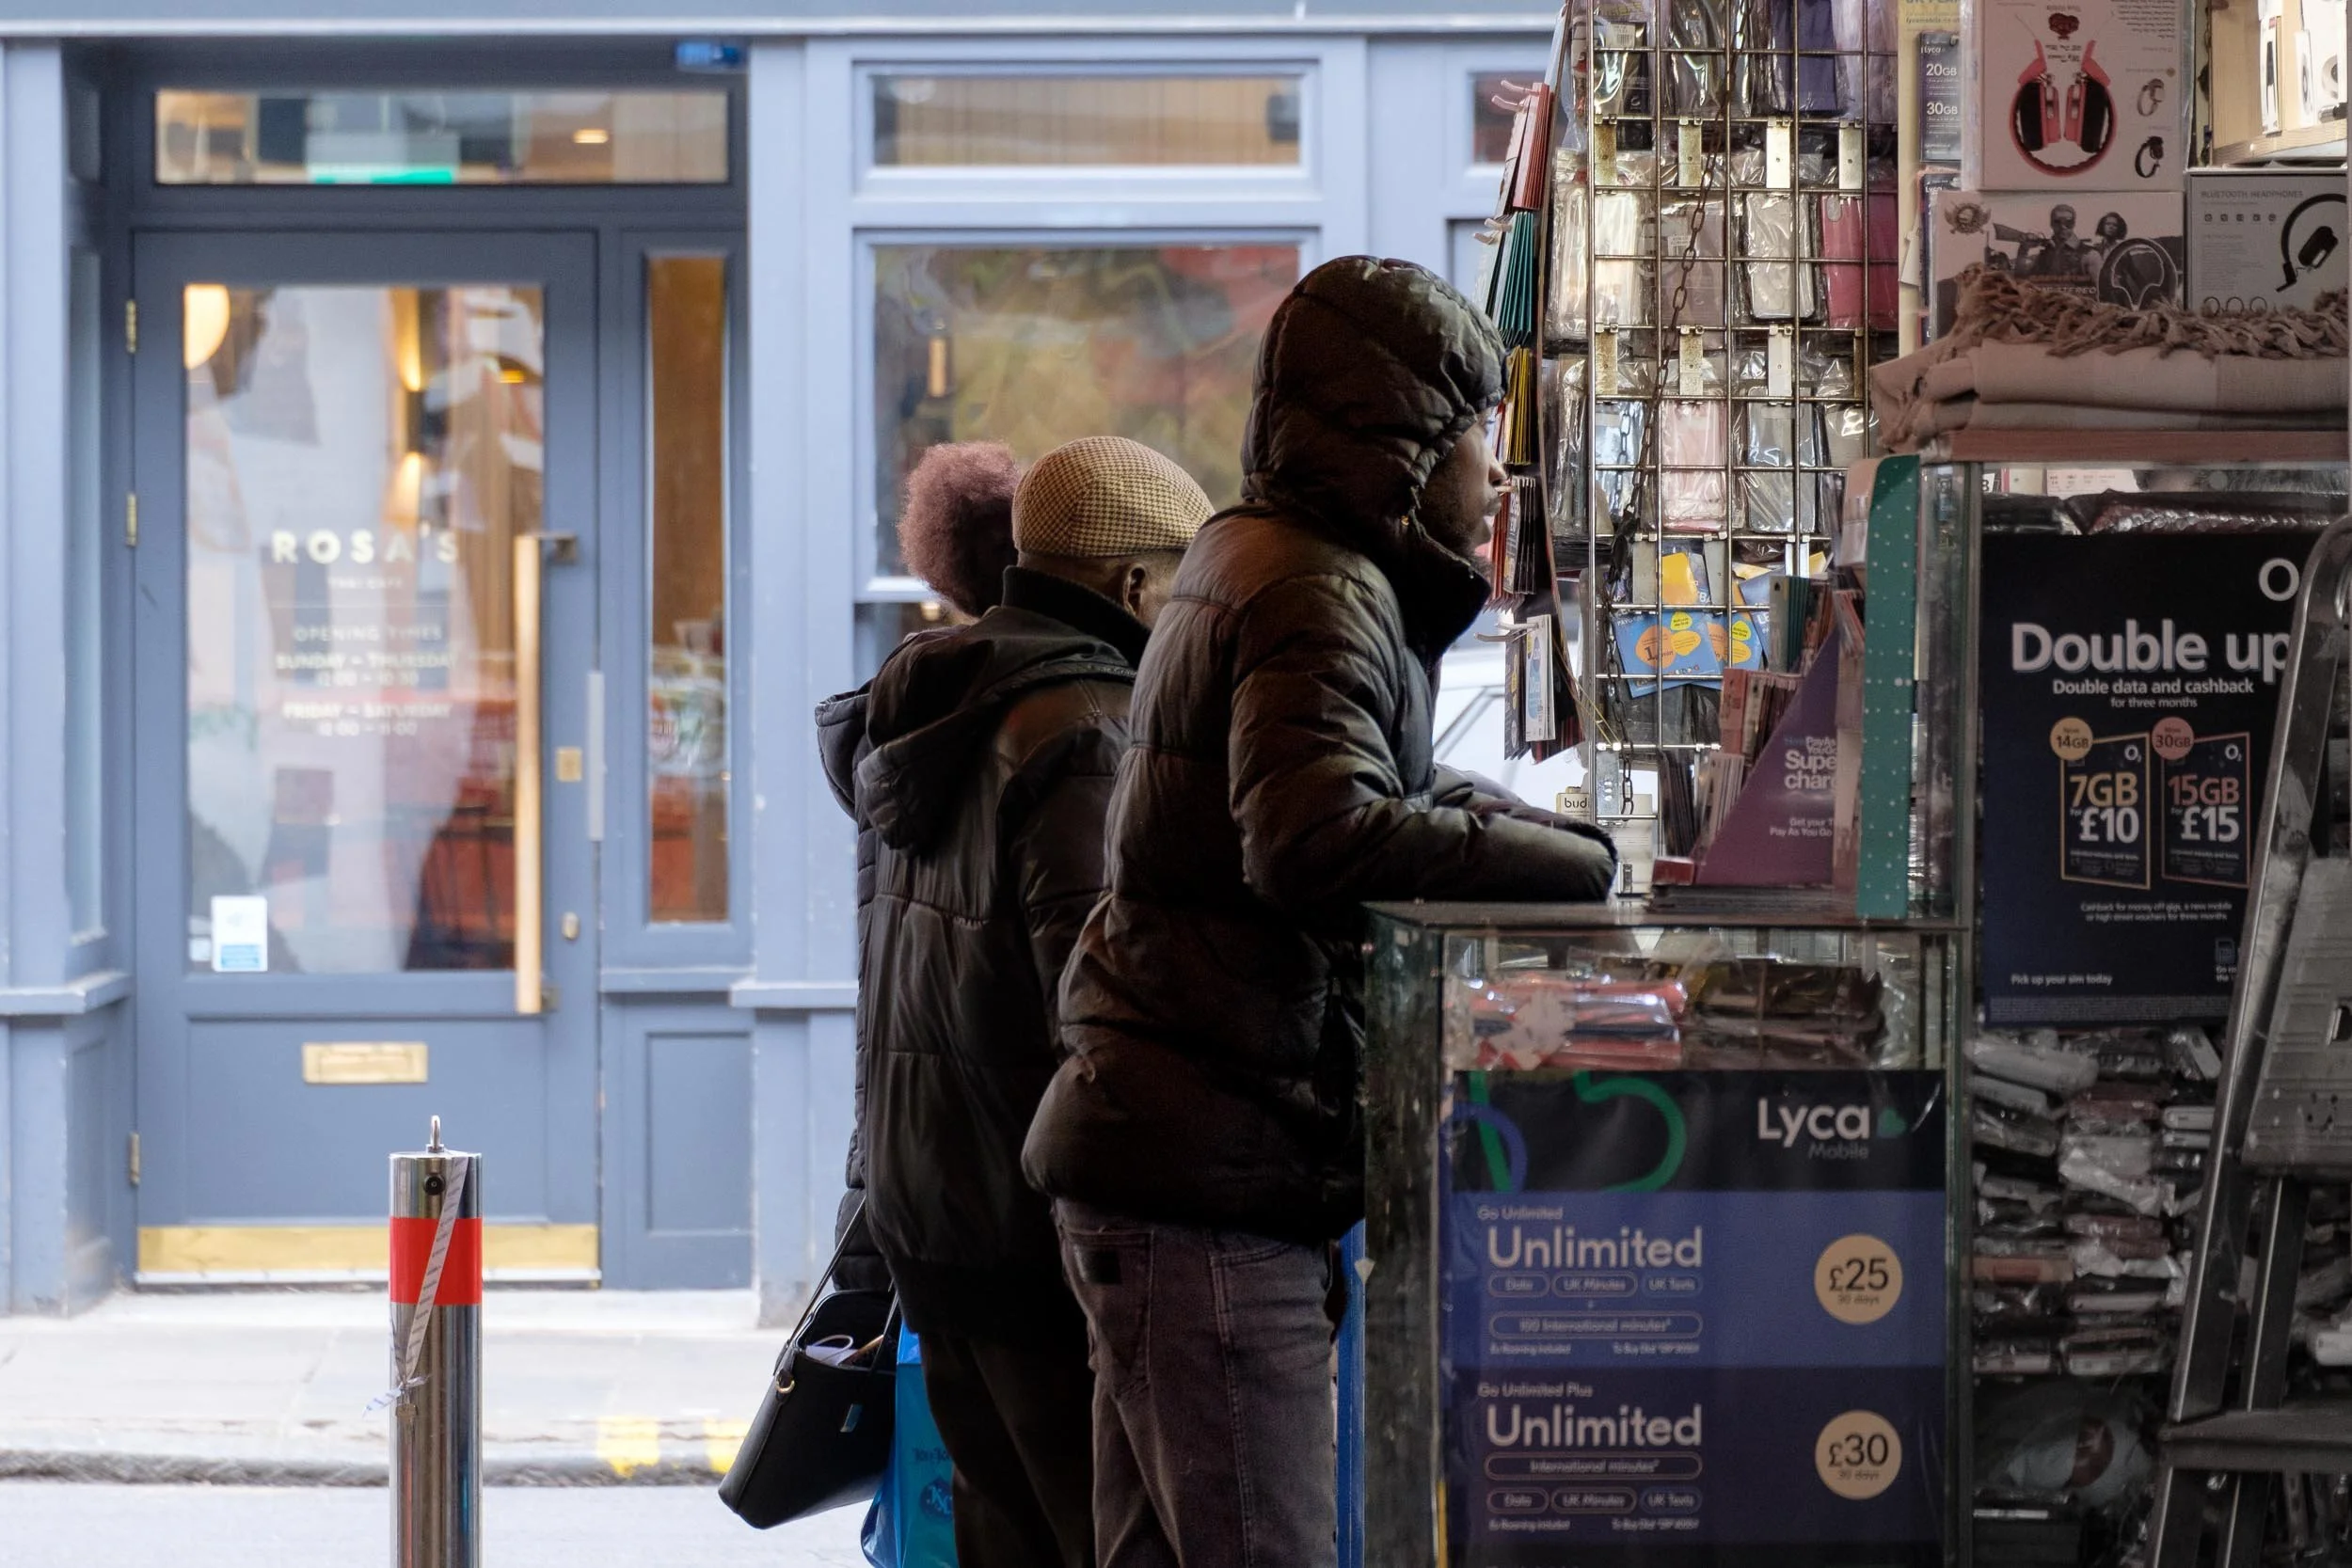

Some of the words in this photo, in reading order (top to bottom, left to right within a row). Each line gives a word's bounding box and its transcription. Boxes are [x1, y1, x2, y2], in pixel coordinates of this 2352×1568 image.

[1926, 63, 1958, 76] 20GB
[1926, 102, 1959, 115] 30GB
[2201, 190, 2249, 198] BLUETOOTH
[2250, 190, 2303, 198] HEADPHONES
[270, 519, 458, 564] ROSA'S
[294, 625, 381, 641] OPENING
[389, 624, 443, 641] TIMES
[2011, 618, 2208, 673] Double
[2225, 630, 2291, 684] up
[276, 653, 345, 669] SUNDAY
[366, 651, 457, 669] THURSDAY
[2053, 679, 2109, 695] Double
[2112, 679, 2148, 695] data
[2151, 679, 2182, 695] and
[2185, 678, 2254, 695] cashback
[281, 702, 343, 719] FRIDAY
[363, 702, 452, 719] SATURDAY
[2110, 697, 2126, 708] for
[2128, 697, 2156, 708] three
[2157, 697, 2198, 708] months
[2056, 735, 2090, 750] 14GB
[2154, 735, 2191, 749] 30GB
[2069, 771, 2139, 808] 7GB
[2167, 774, 2240, 806] 15GB
[1769, 826, 1787, 836] Pay
[1788, 827, 1800, 835] As
[1801, 827, 1818, 836] You
[1819, 827, 1833, 836] Go
[1789, 817, 1805, 826] Get
[1806, 818, 1826, 829] your
[2079, 806, 2140, 844] £10
[2180, 806, 2240, 843] £15
[2115, 901, 2126, 912] for
[2167, 911, 2179, 923] for
[2010, 973, 2029, 985] Pick
[2030, 975, 2043, 986] up
[2044, 975, 2066, 987] your
[2067, 974, 2085, 984] sim
[2086, 973, 2113, 986] today
[1757, 1097, 1870, 1148] Lyca
[1806, 1142, 1870, 1161] Mobile
[1477, 1206, 1499, 1220] Go
[1501, 1205, 1564, 1220] Unlimited
[1487, 1226, 1703, 1268] Unlimited
[1828, 1258, 1890, 1292] £25
[1504, 1276, 1534, 1292] Data
[1563, 1277, 1581, 1292] UK
[1648, 1277, 1666, 1292] UK
[1541, 1319, 1619, 1333] International
[1477, 1383, 1499, 1398] Go
[1502, 1382, 1565, 1398] Unlimited
[1566, 1382, 1594, 1398] Plus
[1486, 1402, 1703, 1447] Unlimited
[1828, 1433, 1890, 1468] £30
[1529, 1459, 1607, 1474] International
[1503, 1494, 1534, 1508] Data
[1562, 1494, 1581, 1508] UK
[1647, 1494, 1666, 1508] UK
